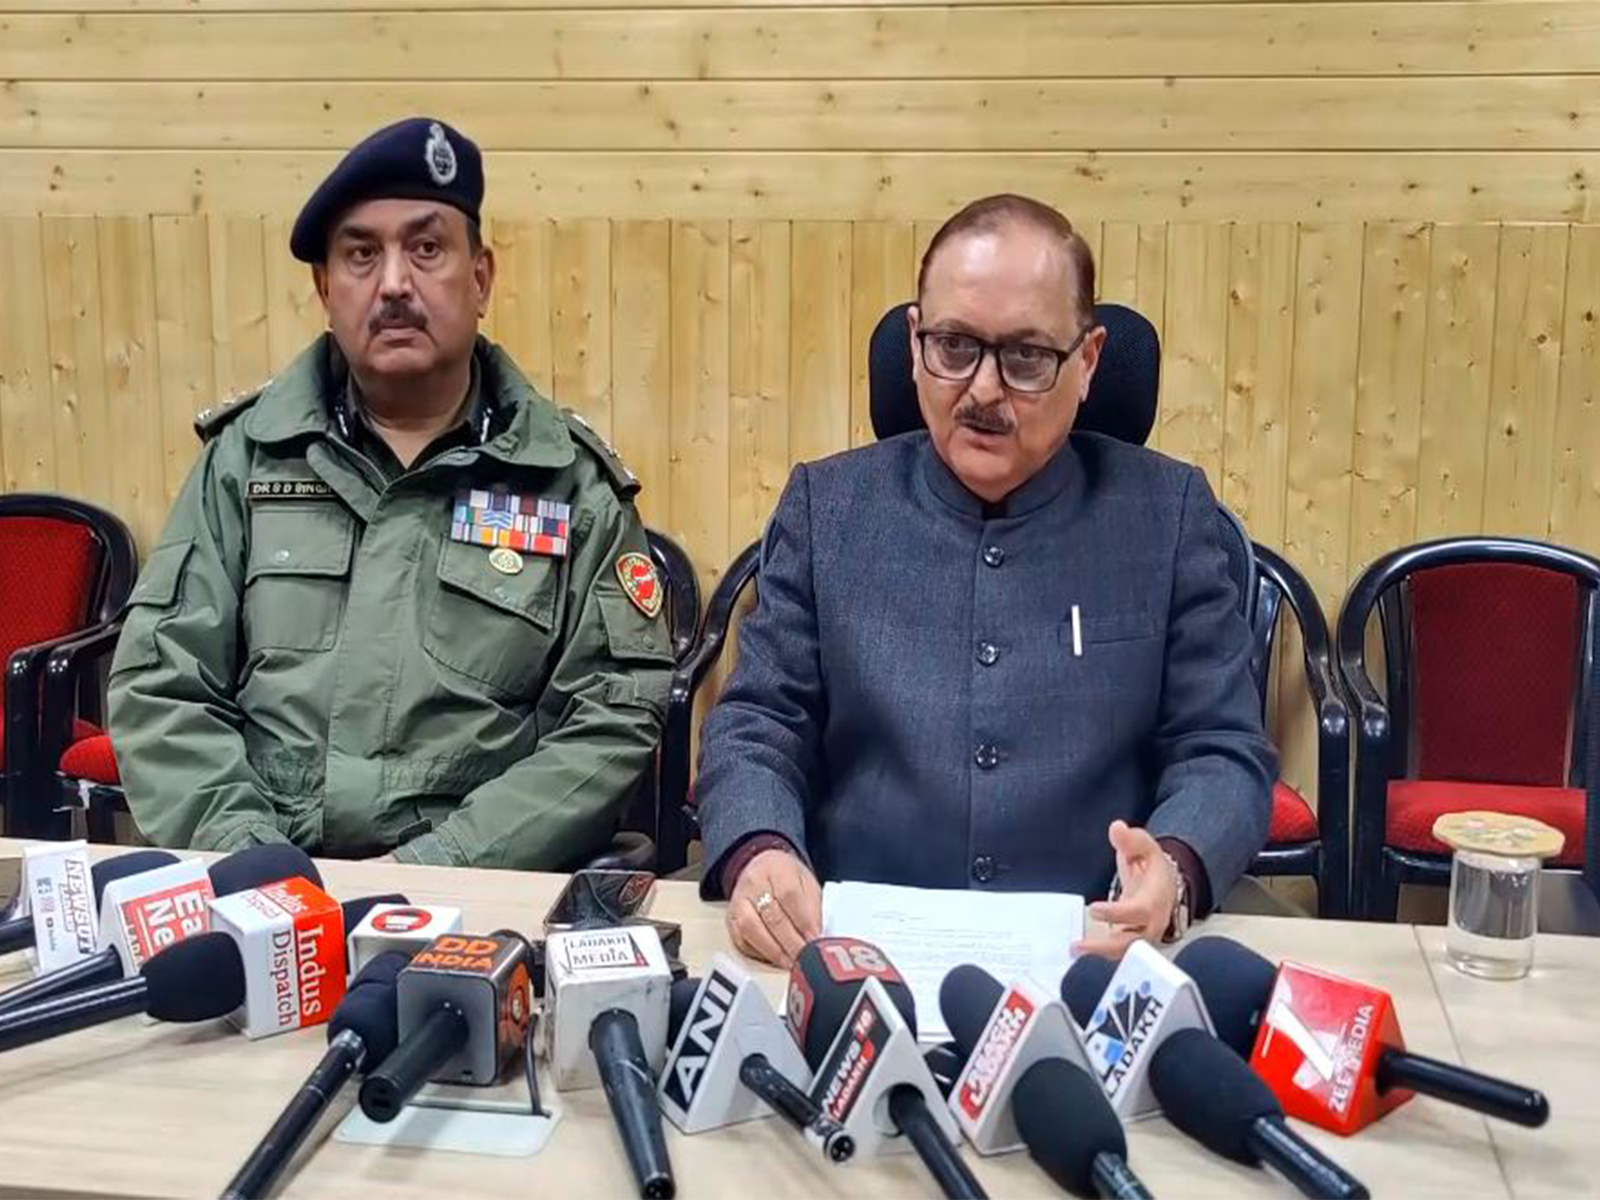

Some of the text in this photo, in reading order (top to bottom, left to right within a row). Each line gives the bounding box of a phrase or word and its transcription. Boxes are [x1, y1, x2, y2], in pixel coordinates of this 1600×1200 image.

[283, 483, 292, 494] D
[145, 898, 176, 947] Ne
[174, 889, 204, 936] Ea
[125, 923, 146, 968] LADA
[434, 936, 499, 954] DD
[569, 936, 627, 948] LADAKH
[572, 949, 629, 965] MEDIA
[825, 944, 888, 972] 18
[269, 929, 298, 1027] Dispatch
[300, 923, 324, 1017] Indus
[676, 979, 733, 1103] ANI
[1328, 1066, 1353, 1113] ZEE
